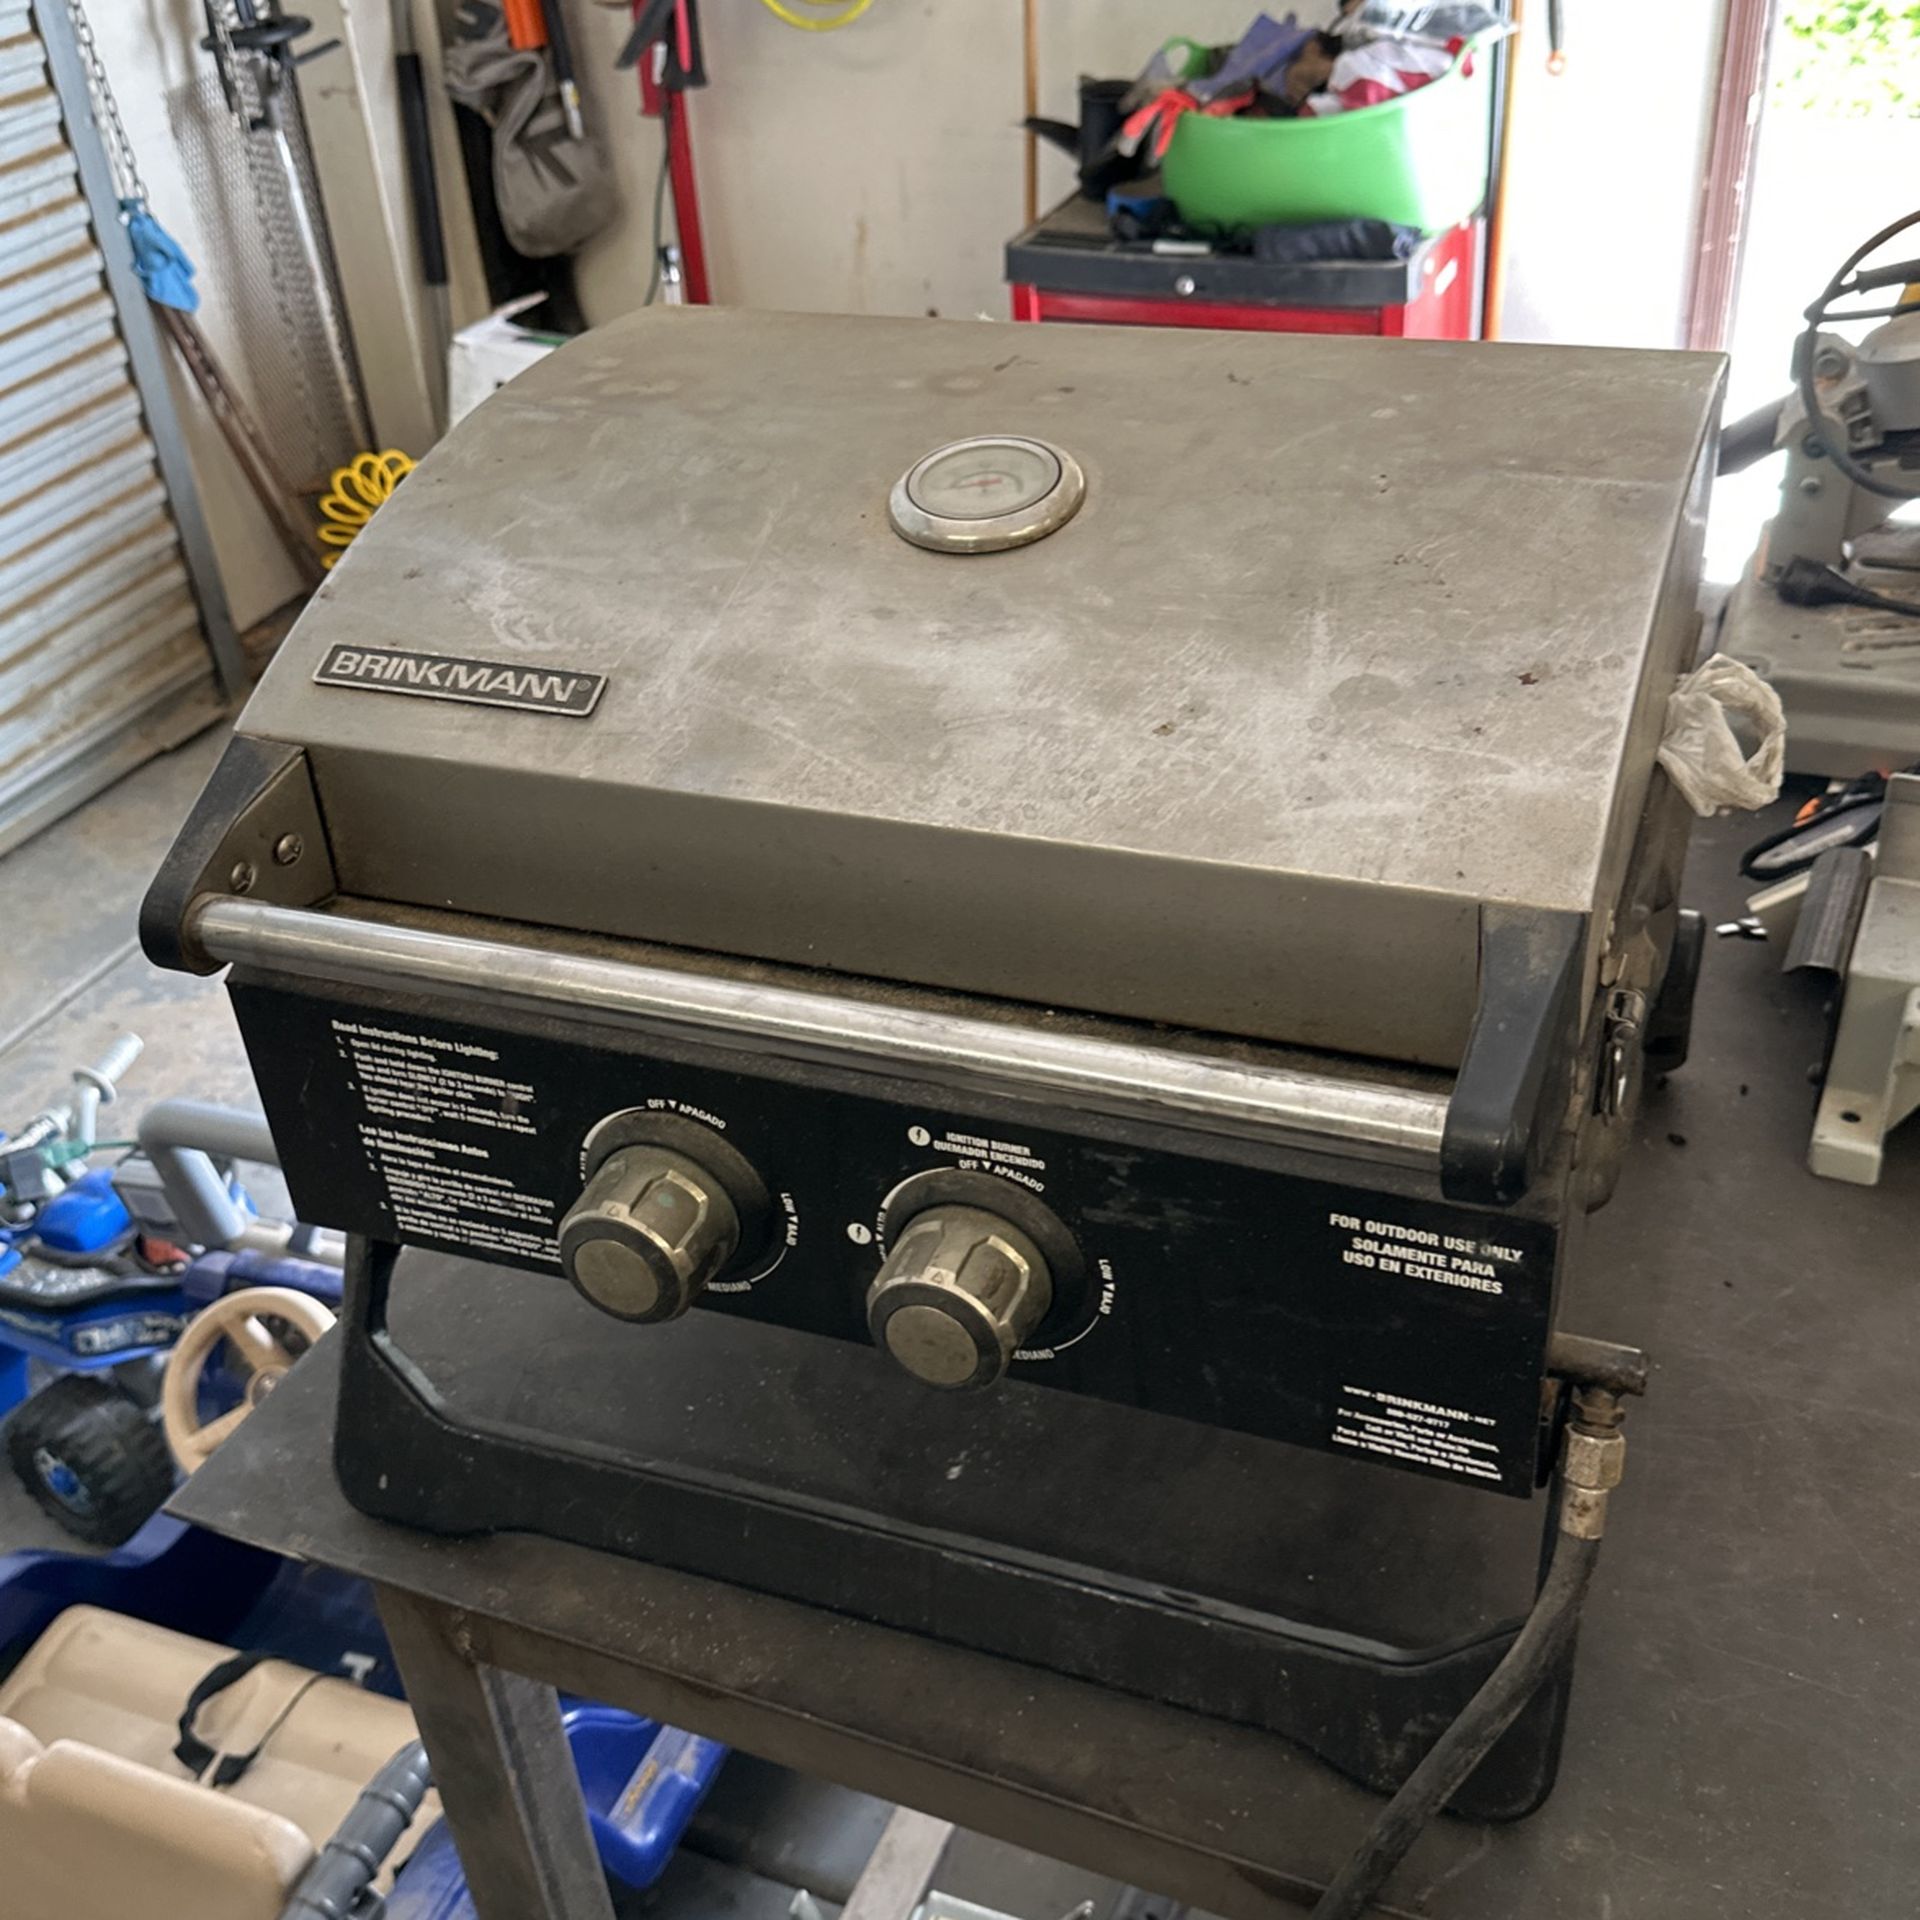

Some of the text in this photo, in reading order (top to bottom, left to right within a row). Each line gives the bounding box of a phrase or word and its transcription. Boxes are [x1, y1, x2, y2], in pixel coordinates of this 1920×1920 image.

[330, 650, 577, 702] BRINKMANN
[331, 1019, 358, 1033] Read
[358, 1024, 419, 1044] Instructions
[419, 1036, 453, 1051] Before
[646, 1098, 727, 1130] OFF APAGADO
[932, 1139, 989, 1159] QUEMADOR
[958, 1159, 1045, 1193] OFF APAGADO
[780, 1192, 797, 1214] LOW
[1329, 1213, 1361, 1231] FOR
[1364, 1220, 1439, 1247] OUTDOOR
[1443, 1235, 1477, 1254] USE
[1097, 1258, 1114, 1281] LOW
[1343, 1250, 1503, 1294] USO EN EXTERIORES
[1352, 1237, 1496, 1278] SOLAMENTE PARA
[1011, 1347, 1056, 1361] EDIANO
